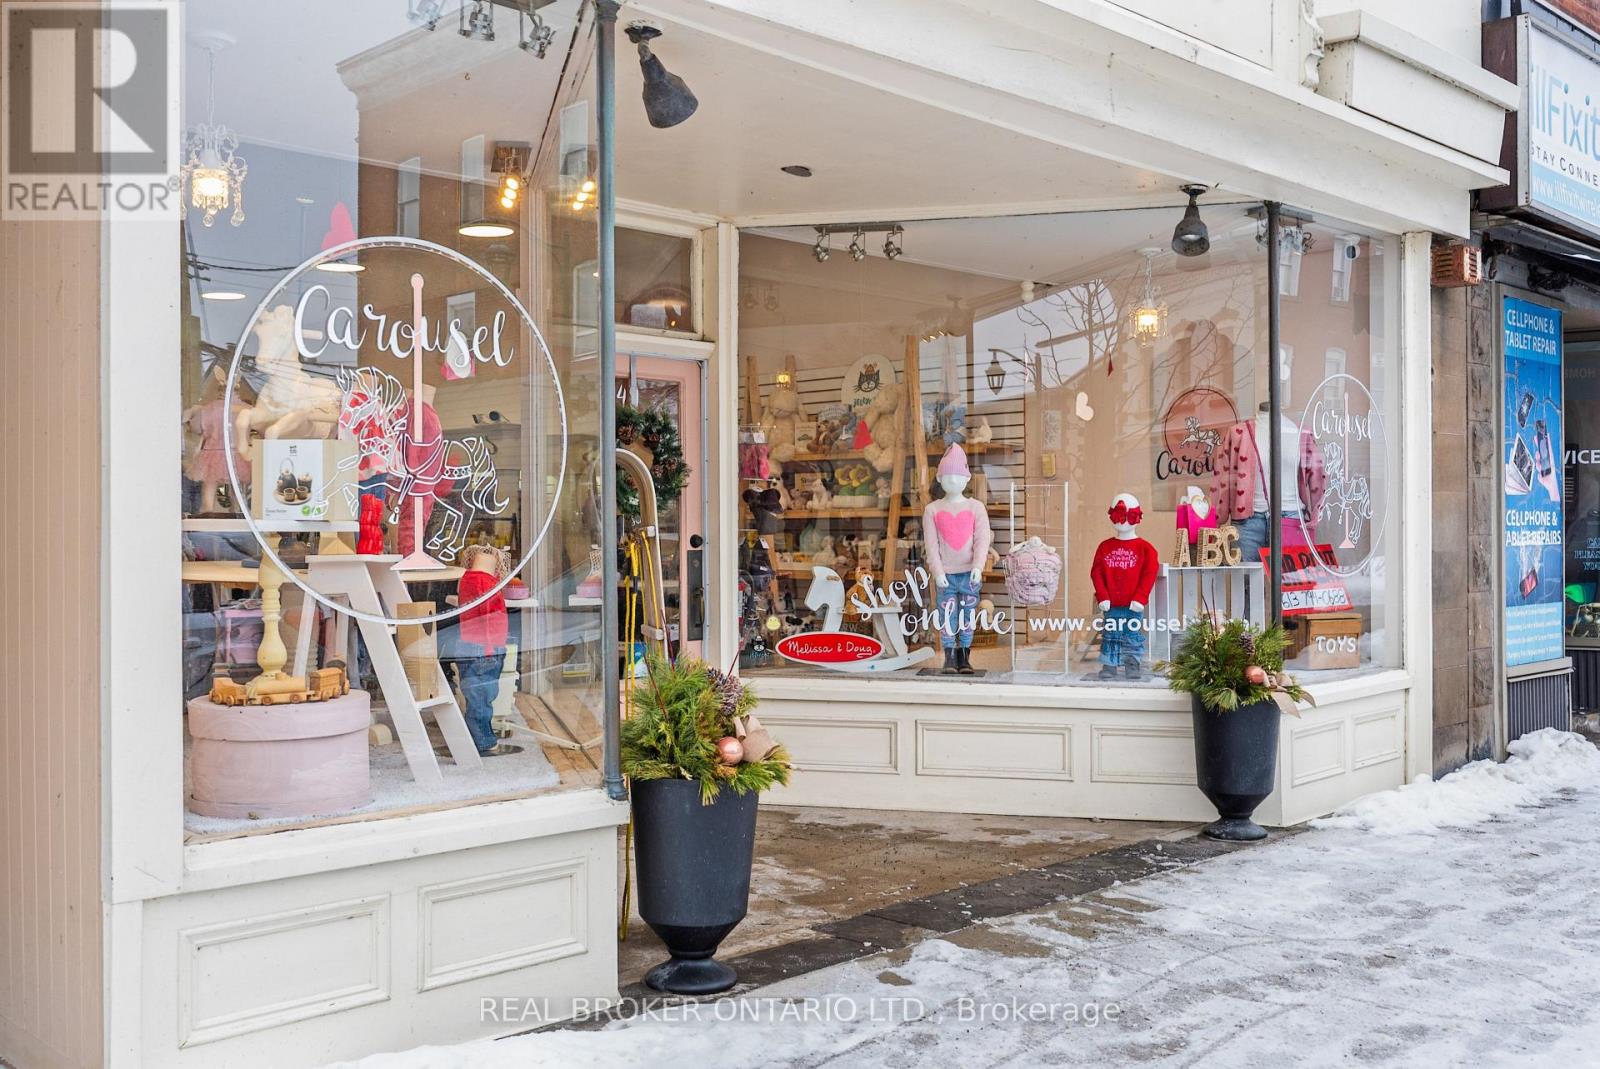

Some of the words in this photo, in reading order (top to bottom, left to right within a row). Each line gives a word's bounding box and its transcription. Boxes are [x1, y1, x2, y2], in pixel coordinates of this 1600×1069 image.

[294, 284, 514, 368] Carousel
[1507, 308, 1549, 333] CELLPHONE
[1549, 319, 1555, 335] &
[1505, 329, 1531, 351] TABLET
[1532, 336, 1557, 356] REPAIR
[1313, 401, 1375, 442] Carousel
[1156, 450, 1215, 481] Carou
[1506, 510, 1550, 527] CELLPHONE
[1551, 511, 1558, 527] &
[899, 601, 1013, 637] online
[787, 641, 833, 656] Melissa
[1315, 635, 1357, 653] TOYS
